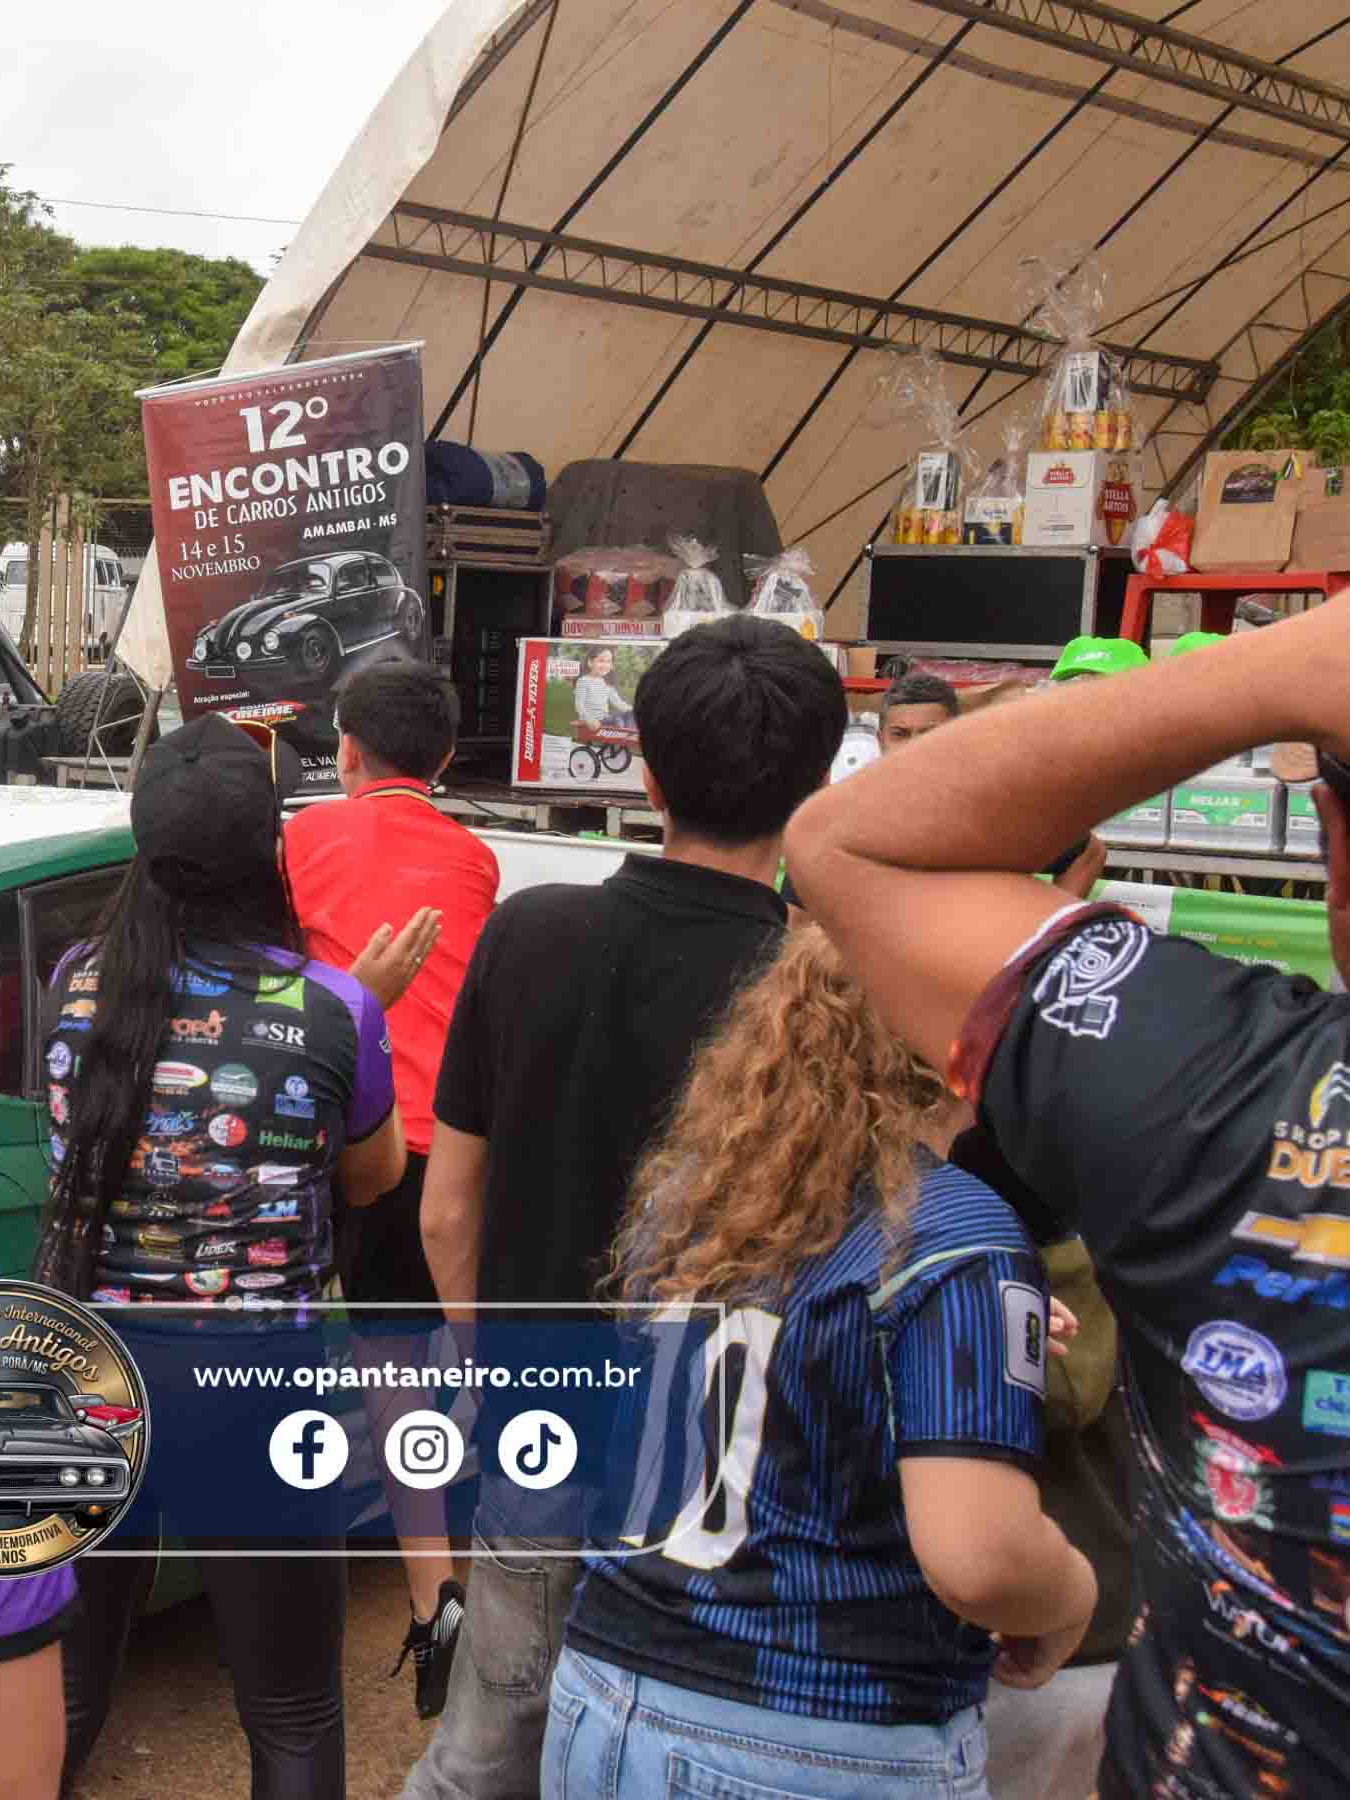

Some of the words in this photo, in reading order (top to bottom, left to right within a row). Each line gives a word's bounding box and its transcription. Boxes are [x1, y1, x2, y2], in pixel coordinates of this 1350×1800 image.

[169, 441, 410, 511] ENCONTRO
[194, 510, 219, 530] DE
[227, 495, 298, 525] CARROS
[306, 481, 387, 513] ANTIGOS
[1105, 488, 1130, 500] STELLA
[180, 542, 204, 561] 14
[207, 542, 216, 557] e
[224, 533, 245, 555] 15
[171, 555, 261, 581] NOVEMBRO
[268, 1023, 306, 1046] SR
[258, 1130, 316, 1152] Heliar
